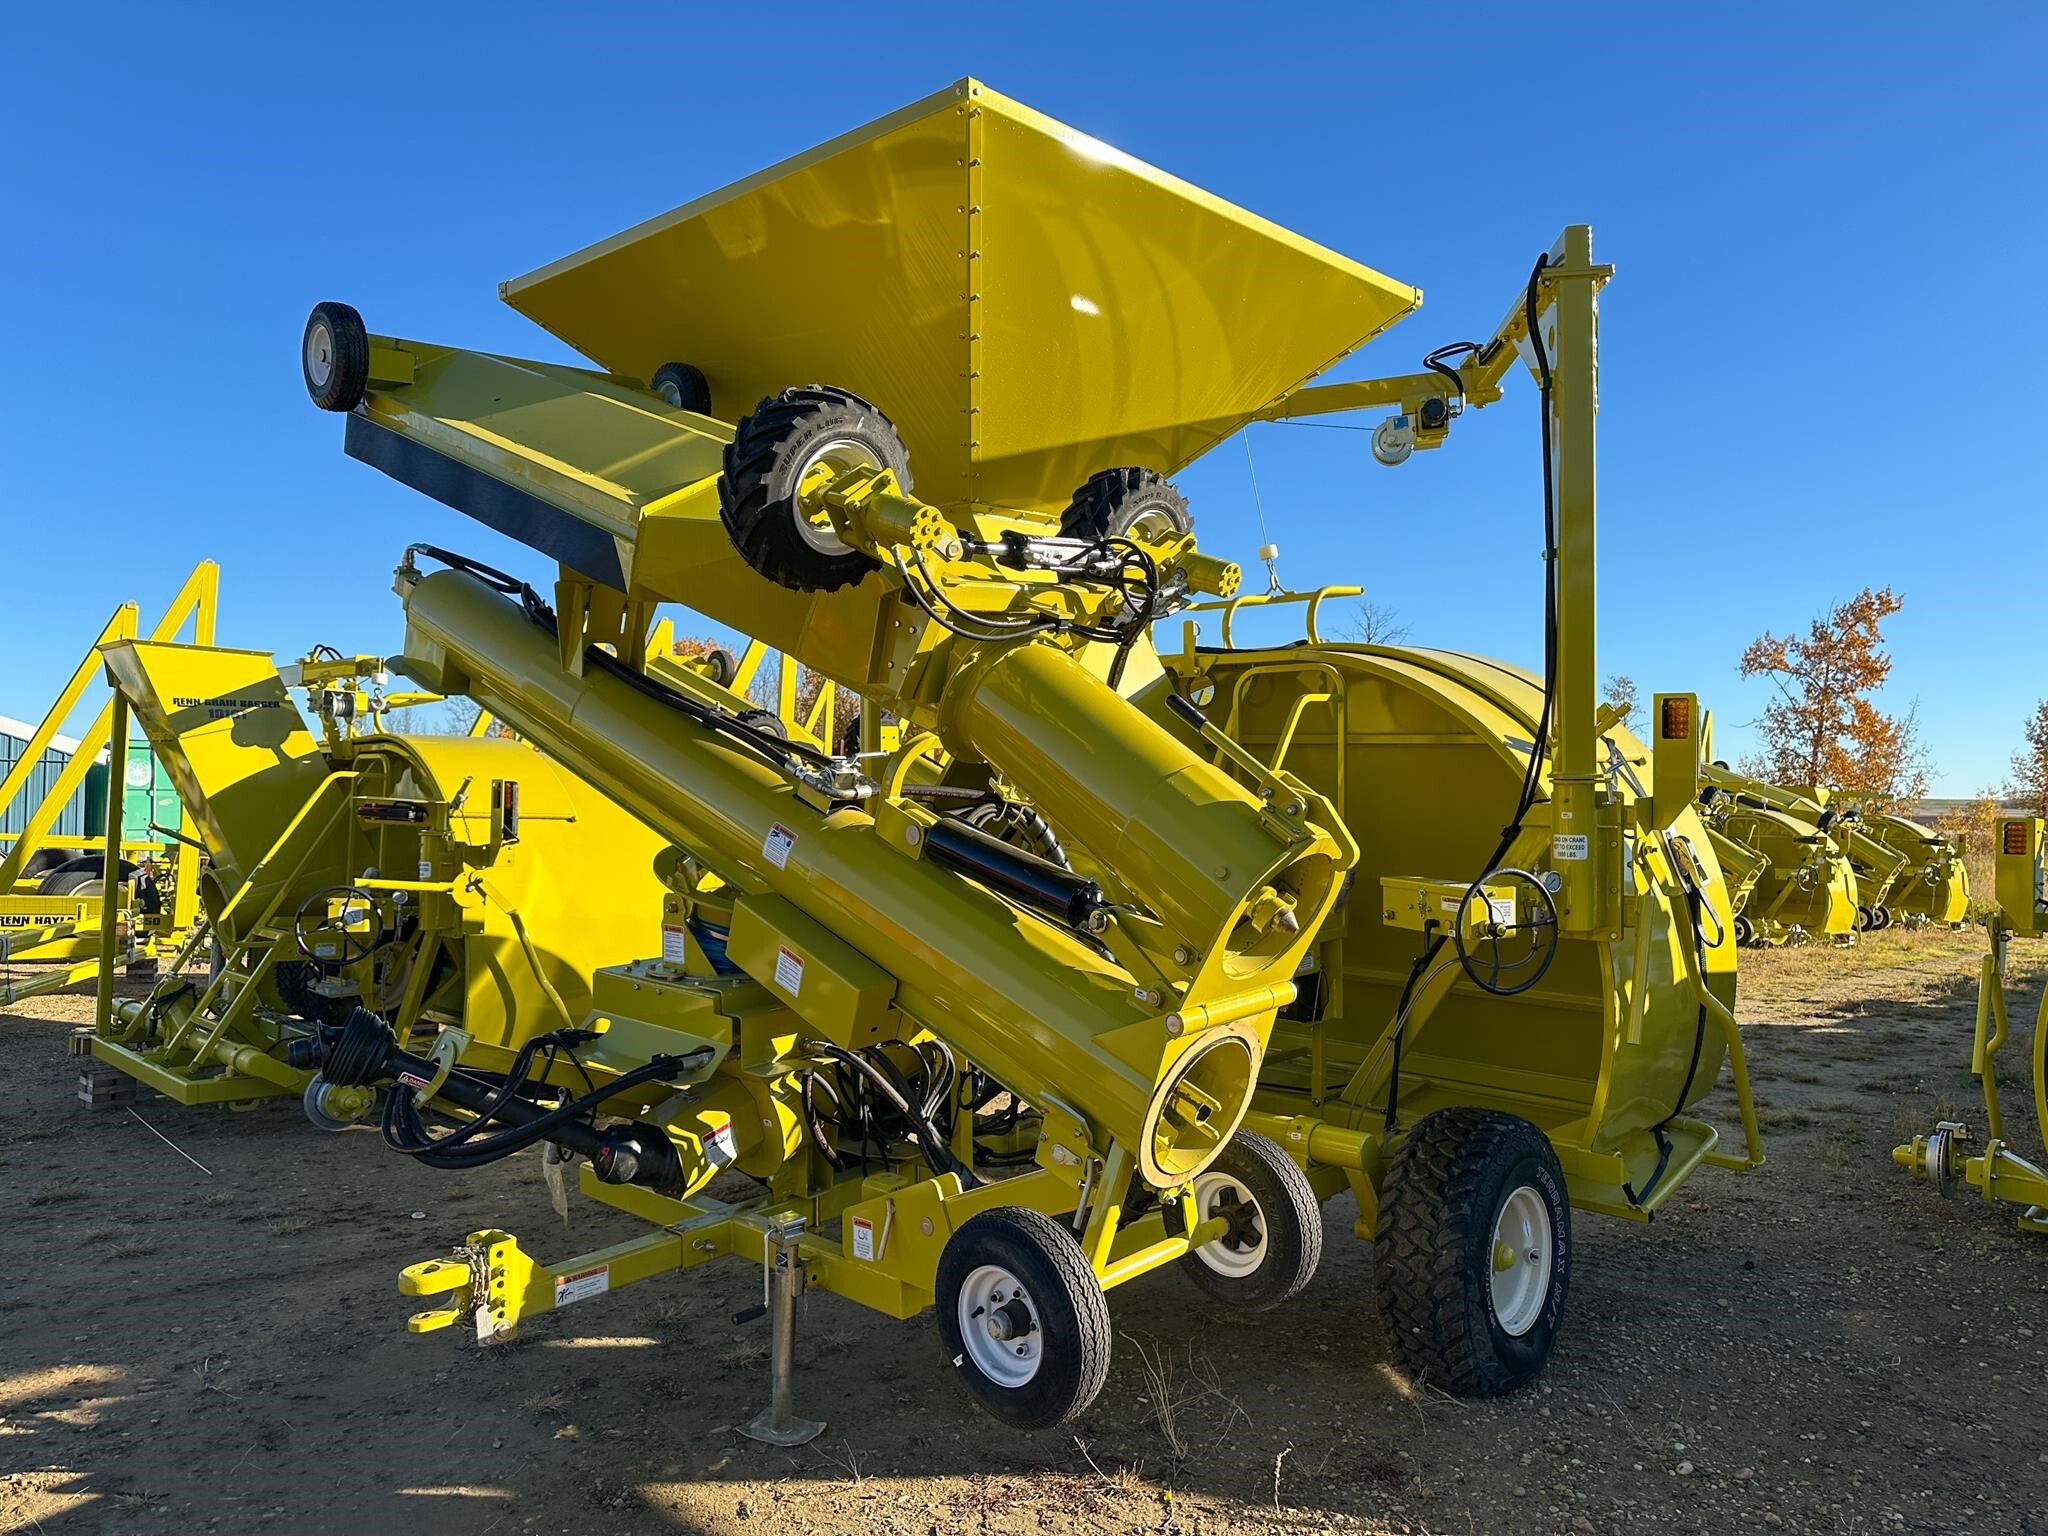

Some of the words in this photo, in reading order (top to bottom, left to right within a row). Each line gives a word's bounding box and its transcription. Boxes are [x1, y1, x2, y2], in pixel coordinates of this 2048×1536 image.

[779, 430, 813, 476] SUPER
[173, 698, 200, 707] RENN
[204, 699, 236, 707] GRAIN
[240, 700, 280, 708] BAGGER
[1537, 1166, 1566, 1274] TERRAMAX
